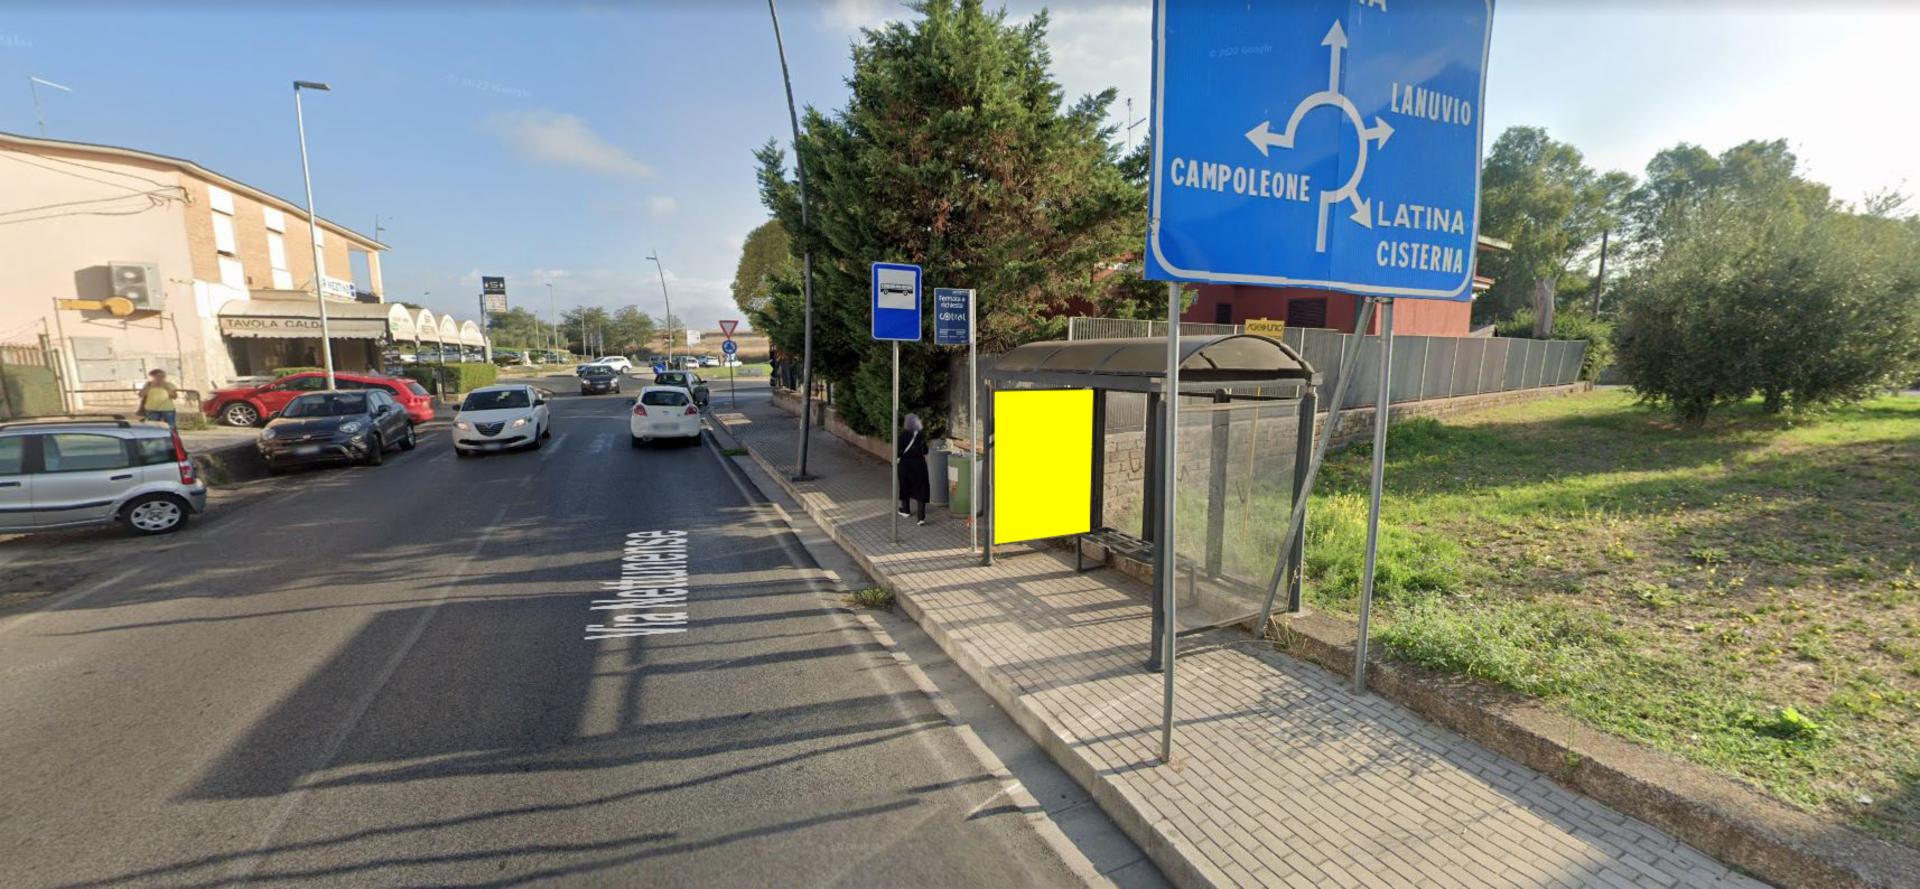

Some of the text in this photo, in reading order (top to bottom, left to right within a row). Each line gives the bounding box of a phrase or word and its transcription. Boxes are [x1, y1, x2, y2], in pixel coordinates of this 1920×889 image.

[1391, 82, 1471, 126] LANUVIO
[1170, 157, 1310, 202] CAMPOLEONE
[1378, 201, 1465, 235] LATINA
[1376, 240, 1463, 274] CISTERNA
[227, 318, 278, 329] TAVOLA
